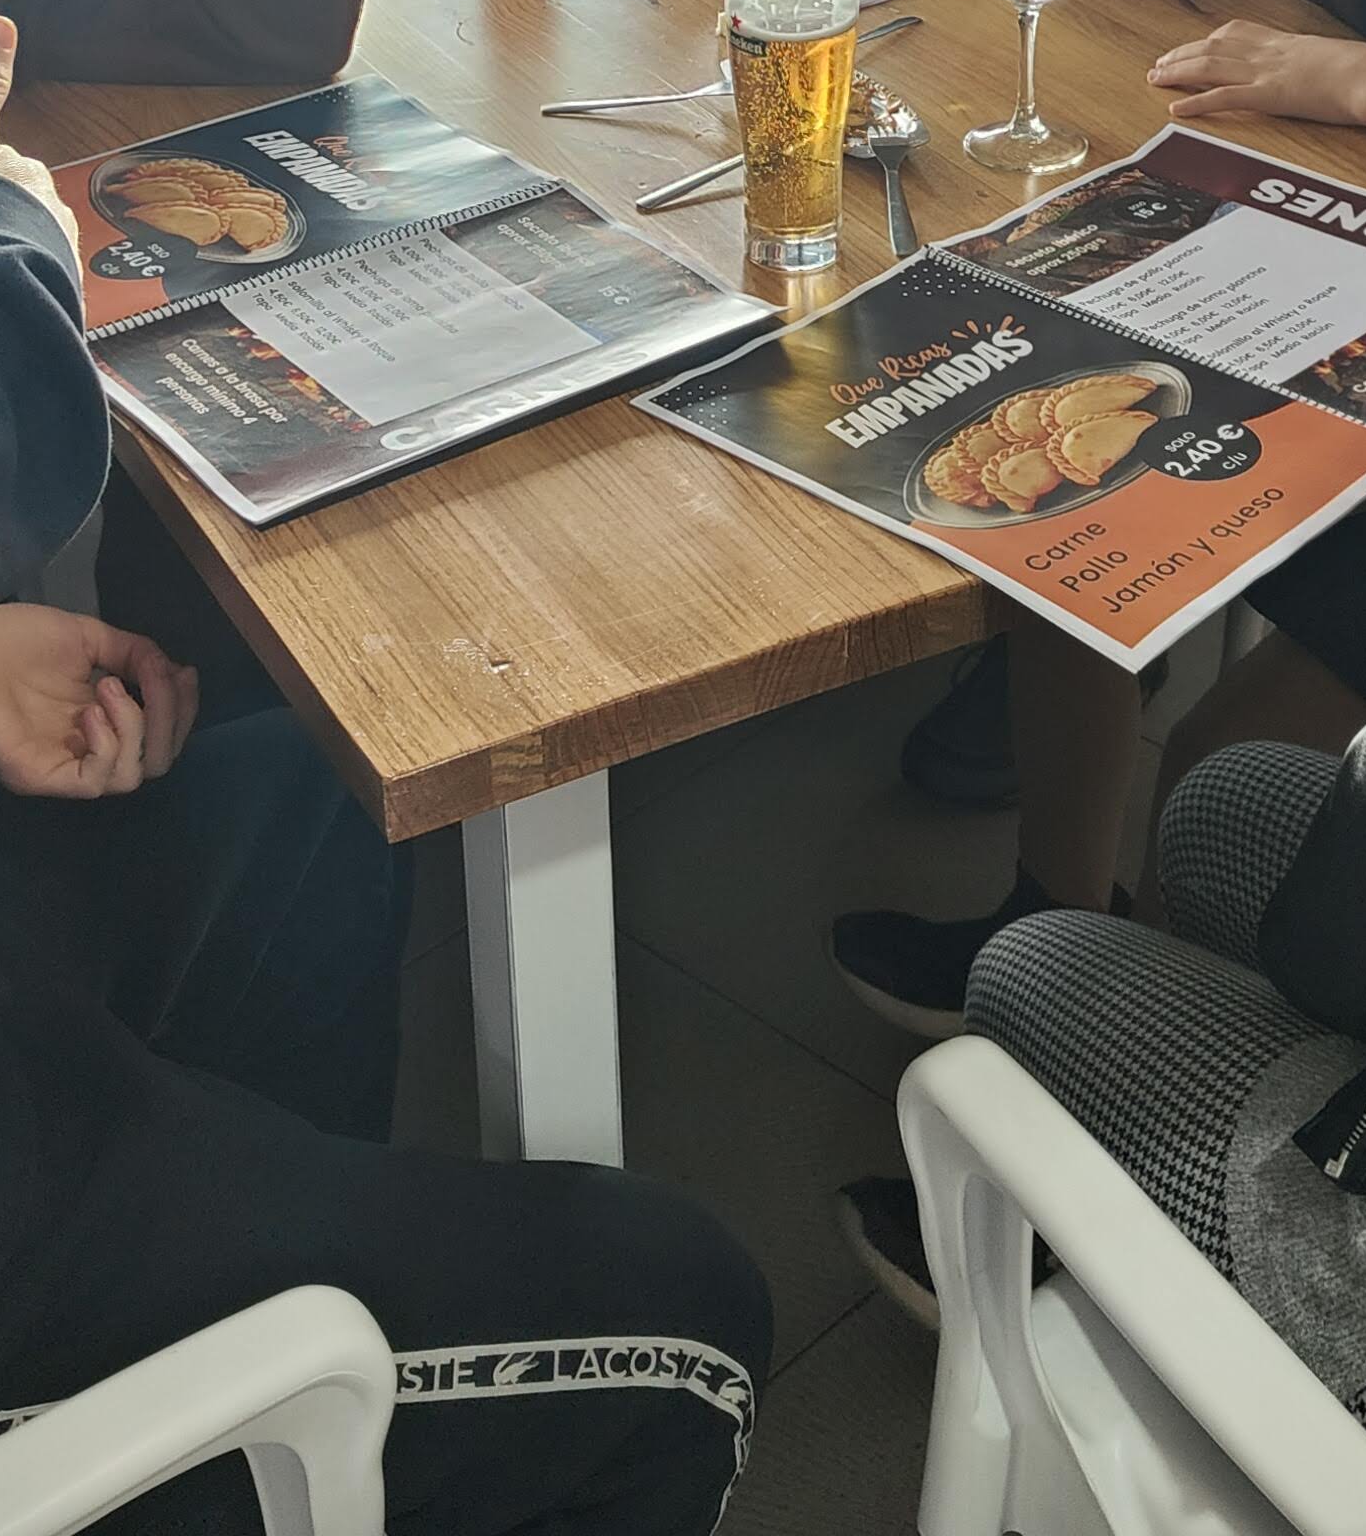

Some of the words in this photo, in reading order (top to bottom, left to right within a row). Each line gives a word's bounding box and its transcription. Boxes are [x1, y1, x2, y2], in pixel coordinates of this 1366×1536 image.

[242, 129, 379, 212] EMPANADAS
[1005, 244, 1057, 269] Secreto
[1025, 253, 1066, 277] aprox
[1061, 236, 1109, 263] 250grs
[1123, 278, 1140, 289] de
[1162, 244, 1204, 270] plancha
[320, 270, 342, 290] Tapa
[1141, 310, 1188, 332] Pechuga
[1186, 302, 1202, 313] de
[1225, 265, 1268, 293] plancha
[1141, 291, 1172, 309] Media
[252, 291, 274, 312] Tapa
[1251, 325, 1266, 337] al
[1302, 285, 1338, 306] Roque
[1204, 314, 1237, 334] Media
[164, 351, 210, 386] encargo
[1269, 339, 1302, 360] Media
[181, 338, 221, 369] Carnes
[222, 371, 241, 385] la
[234, 380, 270, 409] brasa
[257, 406, 289, 424] por
[823, 329, 1035, 450] EMPANADAS
[830, 376, 885, 406] Que
[877, 342, 953, 382] Ricas
[154, 375, 211, 416] personas
[1163, 430, 1197, 453] SOLO
[1163, 438, 1224, 479] 2,40
[1216, 423, 1245, 442] €
[1221, 451, 1249, 472] c/u
[1024, 520, 1107, 573] Carne
[1101, 550, 1195, 615] Jamón
[1186, 536, 1217, 557] y
[1209, 486, 1285, 539] queso
[1058, 549, 1129, 594] Pollo
[551, 1346, 713, 1386] LACOSTE
